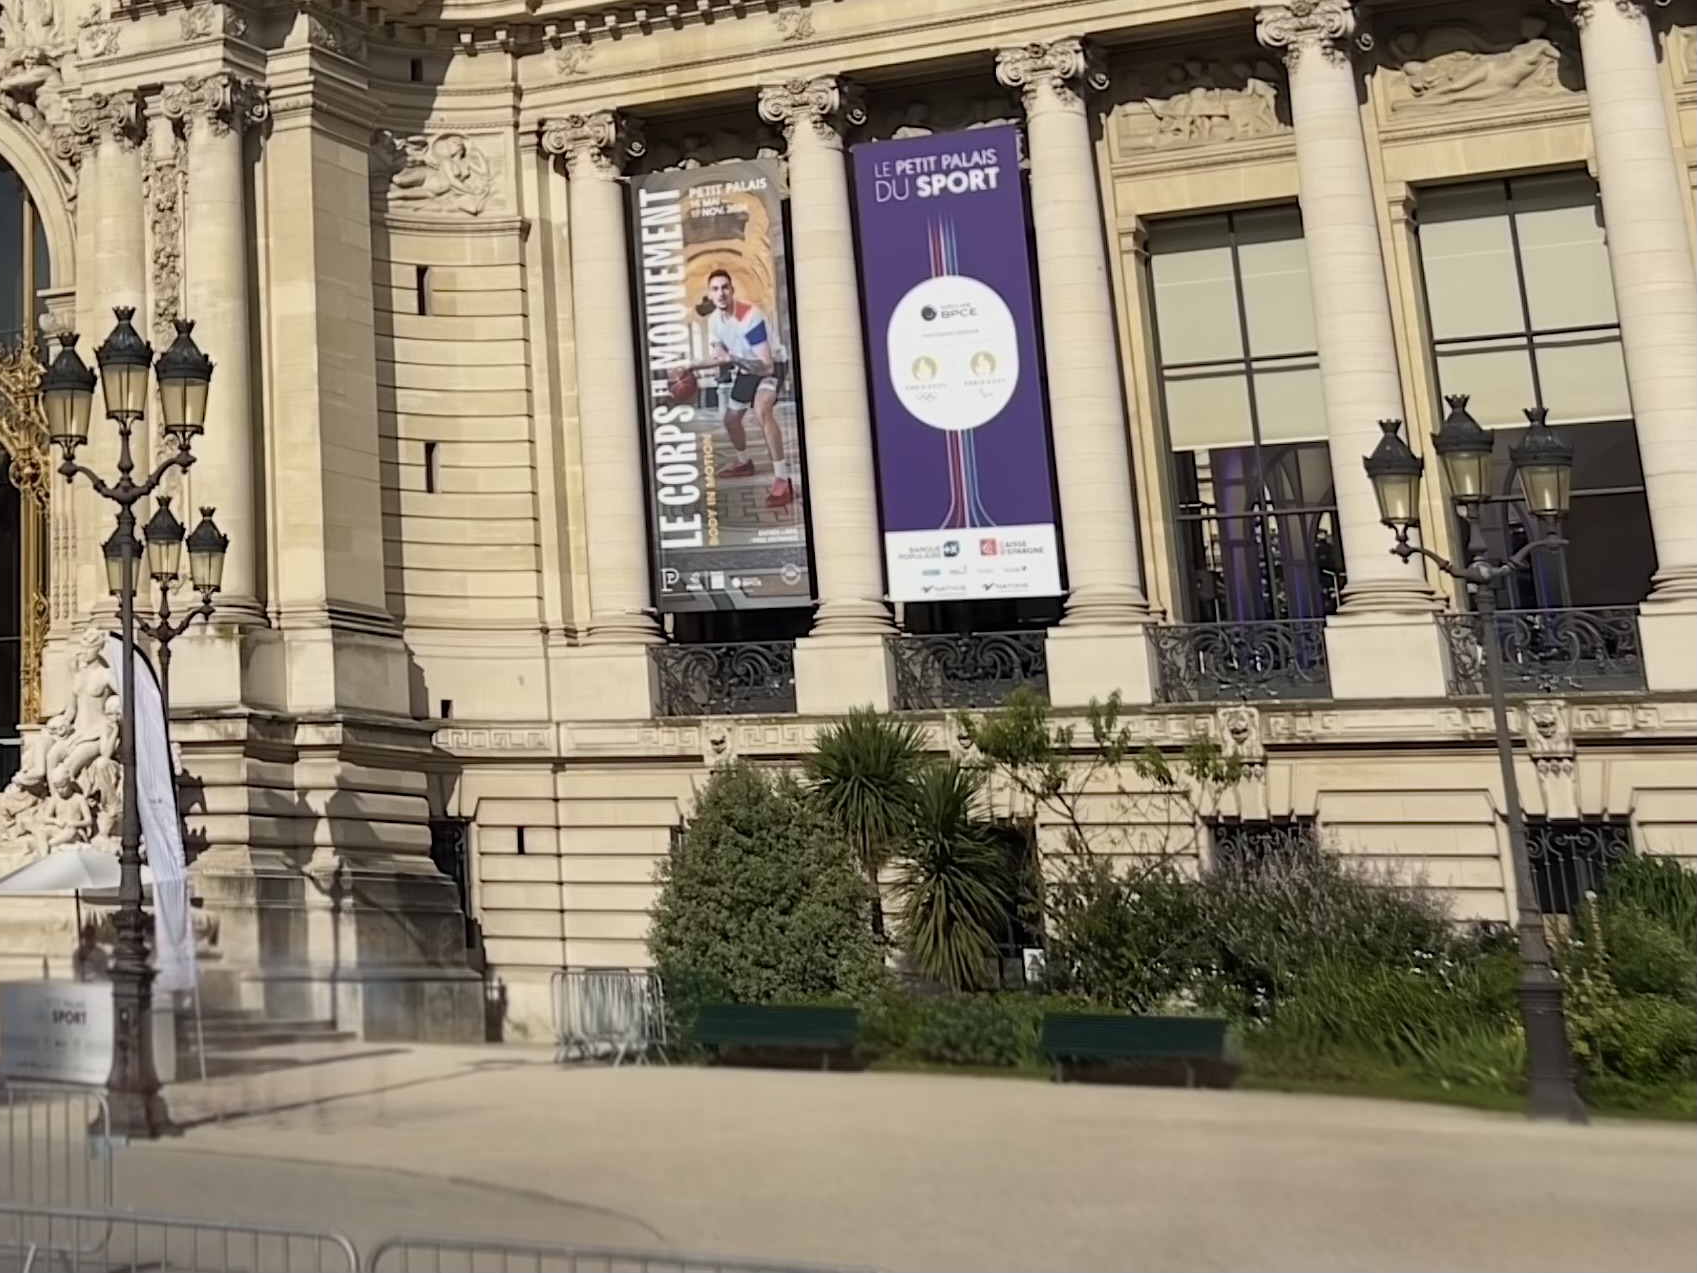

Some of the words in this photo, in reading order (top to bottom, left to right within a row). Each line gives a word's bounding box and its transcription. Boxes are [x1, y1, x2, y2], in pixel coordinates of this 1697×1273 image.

[874, 161, 891, 178] LE
[895, 155, 937, 176] PETIT
[941, 148, 998, 170] PALAIS
[689, 184, 722, 199] PETIT
[725, 177, 767, 194] PALAIS
[875, 178, 909, 202] DU
[916, 166, 1000, 198] SPORT
[639, 188, 691, 370] MOUVEMENT
[941, 308, 978, 319] BPCE
[652, 405, 701, 506] CORPS
[702, 434, 716, 488] MOTION
[706, 491, 717, 506] IN
[659, 513, 704, 549] LE
[52, 1009, 86, 1025] SPORT
